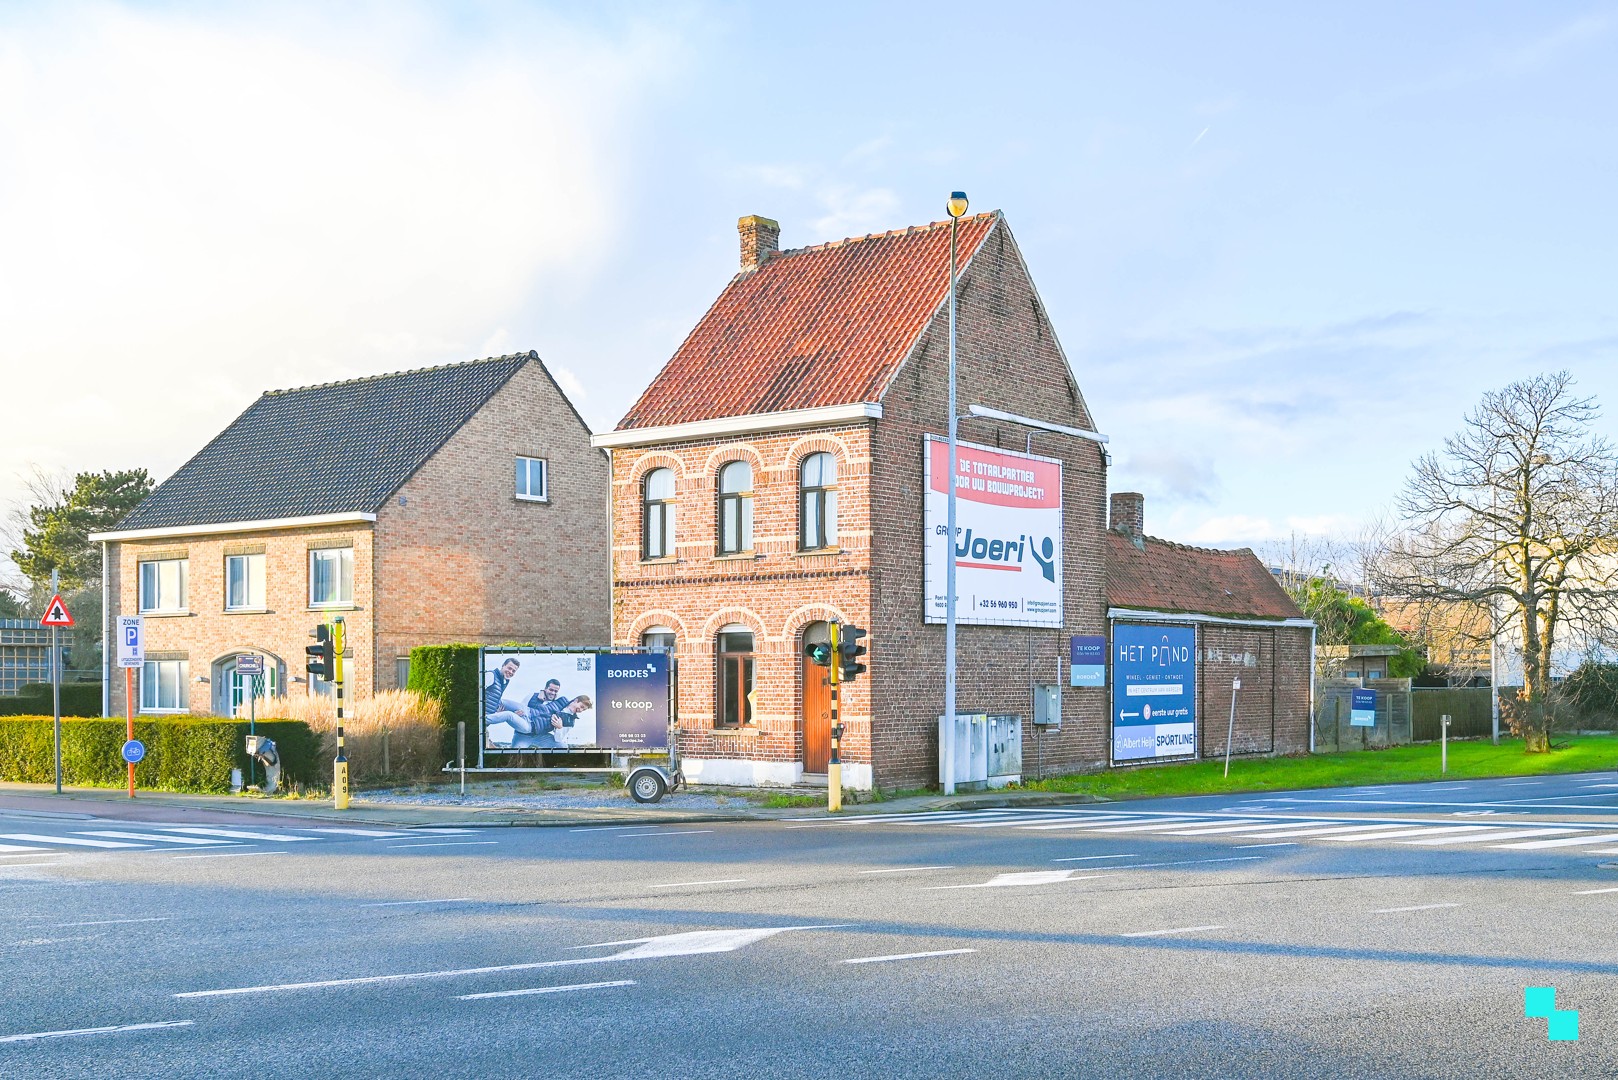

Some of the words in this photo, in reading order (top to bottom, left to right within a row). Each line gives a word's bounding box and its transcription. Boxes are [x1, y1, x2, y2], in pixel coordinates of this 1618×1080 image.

[960, 460, 970, 472] DE
[973, 462, 1035, 483] TOTAALPARTNER
[955, 476, 969, 489] OOR
[972, 478, 984, 491] UW
[987, 480, 1044, 500] BOUWPROJECT!
[936, 525, 962, 537] GRP
[955, 529, 1025, 562] Joeri
[979, 600, 989, 608] +32
[990, 600, 997, 608] 56
[998, 600, 1008, 609] 960
[1008, 601, 1018, 609] 950
[1120, 645, 1144, 662] HET
[607, 669, 649, 678] BORDES
[611, 700, 622, 709] te
[625, 699, 653, 711] koop
